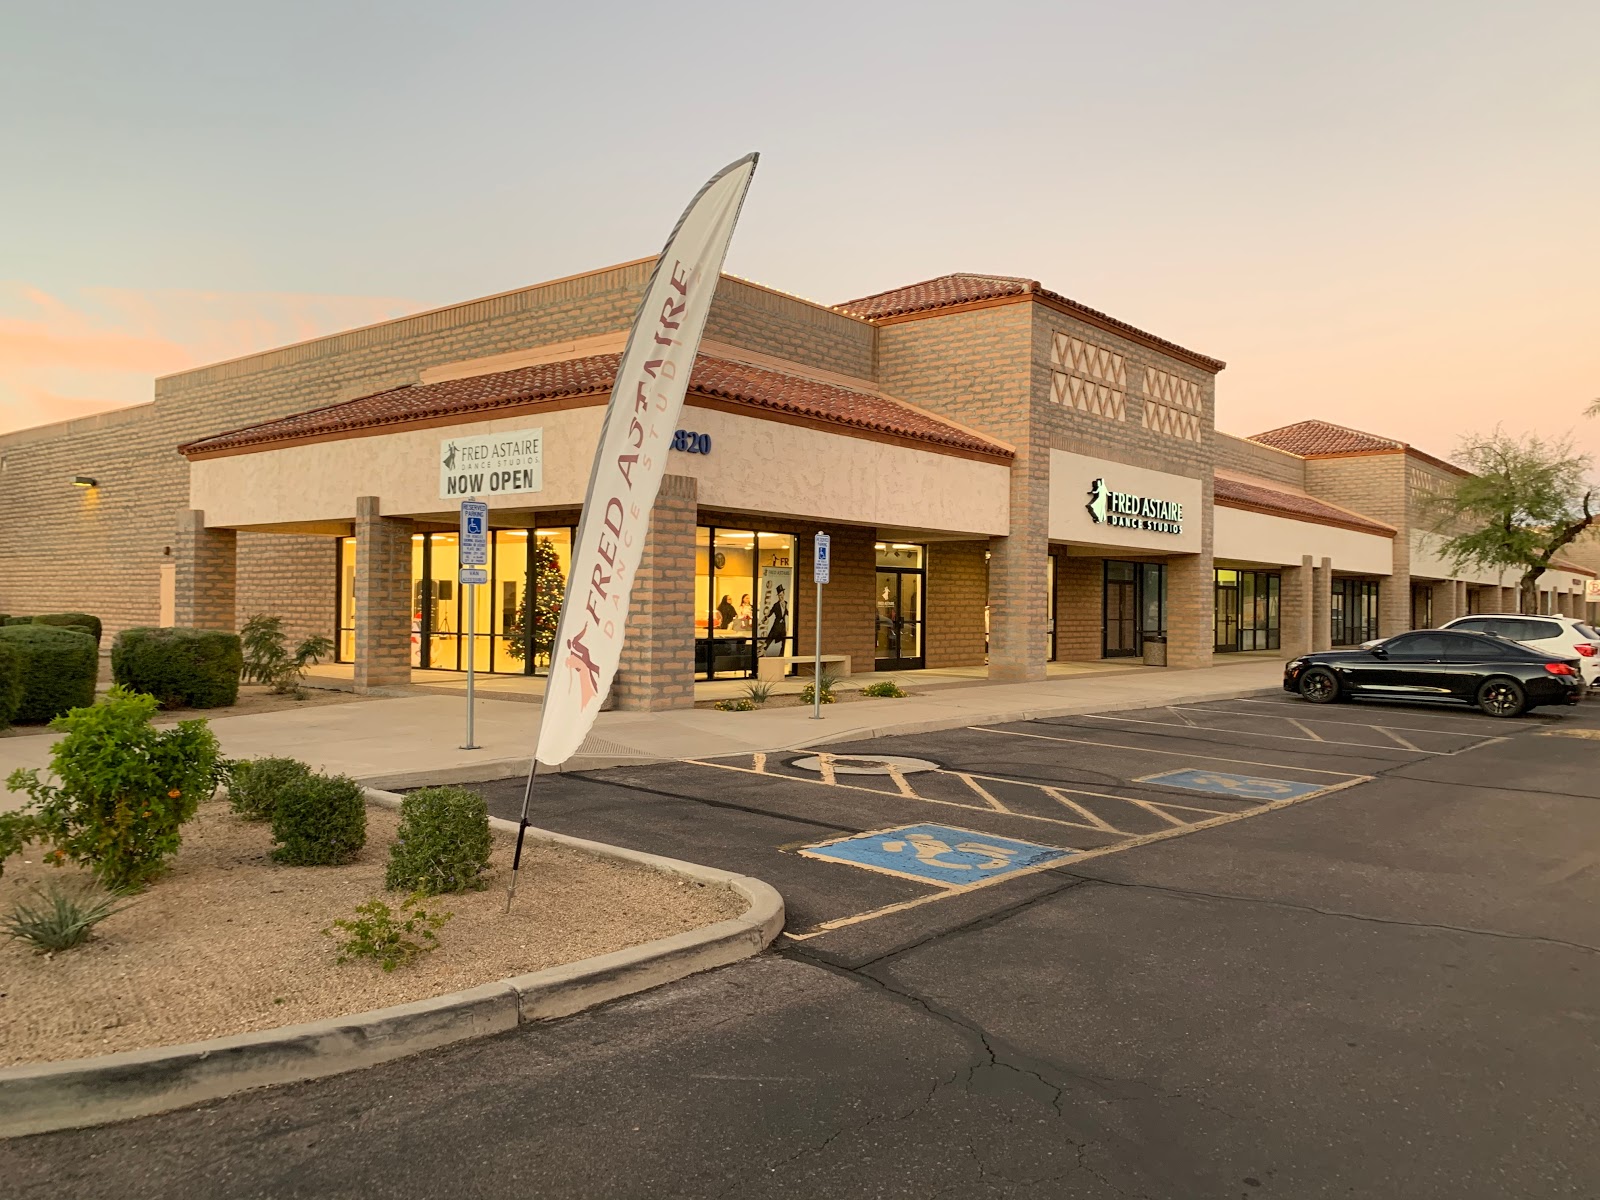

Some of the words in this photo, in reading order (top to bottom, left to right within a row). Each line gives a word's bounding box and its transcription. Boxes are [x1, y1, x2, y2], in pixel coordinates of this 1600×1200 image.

[461, 445, 489, 461] FRED
[491, 438, 539, 459] ASTAIRE
[586, 497, 625, 627] FRED
[617, 259, 690, 491] ASTAIRE
[669, 429, 712, 455] 820
[461, 461, 491, 471] DANCE
[497, 456, 539, 467] STUDIOS
[447, 473, 484, 495] NOW
[489, 468, 534, 492] OPEN
[464, 510, 484, 518] PARKING
[1111, 491, 1140, 515] FRED
[1141, 497, 1184, 522] ASTAIRE
[1112, 515, 1143, 529] DANCE
[1147, 520, 1183, 534] STUDIOS
[603, 503, 640, 639] DANCE
